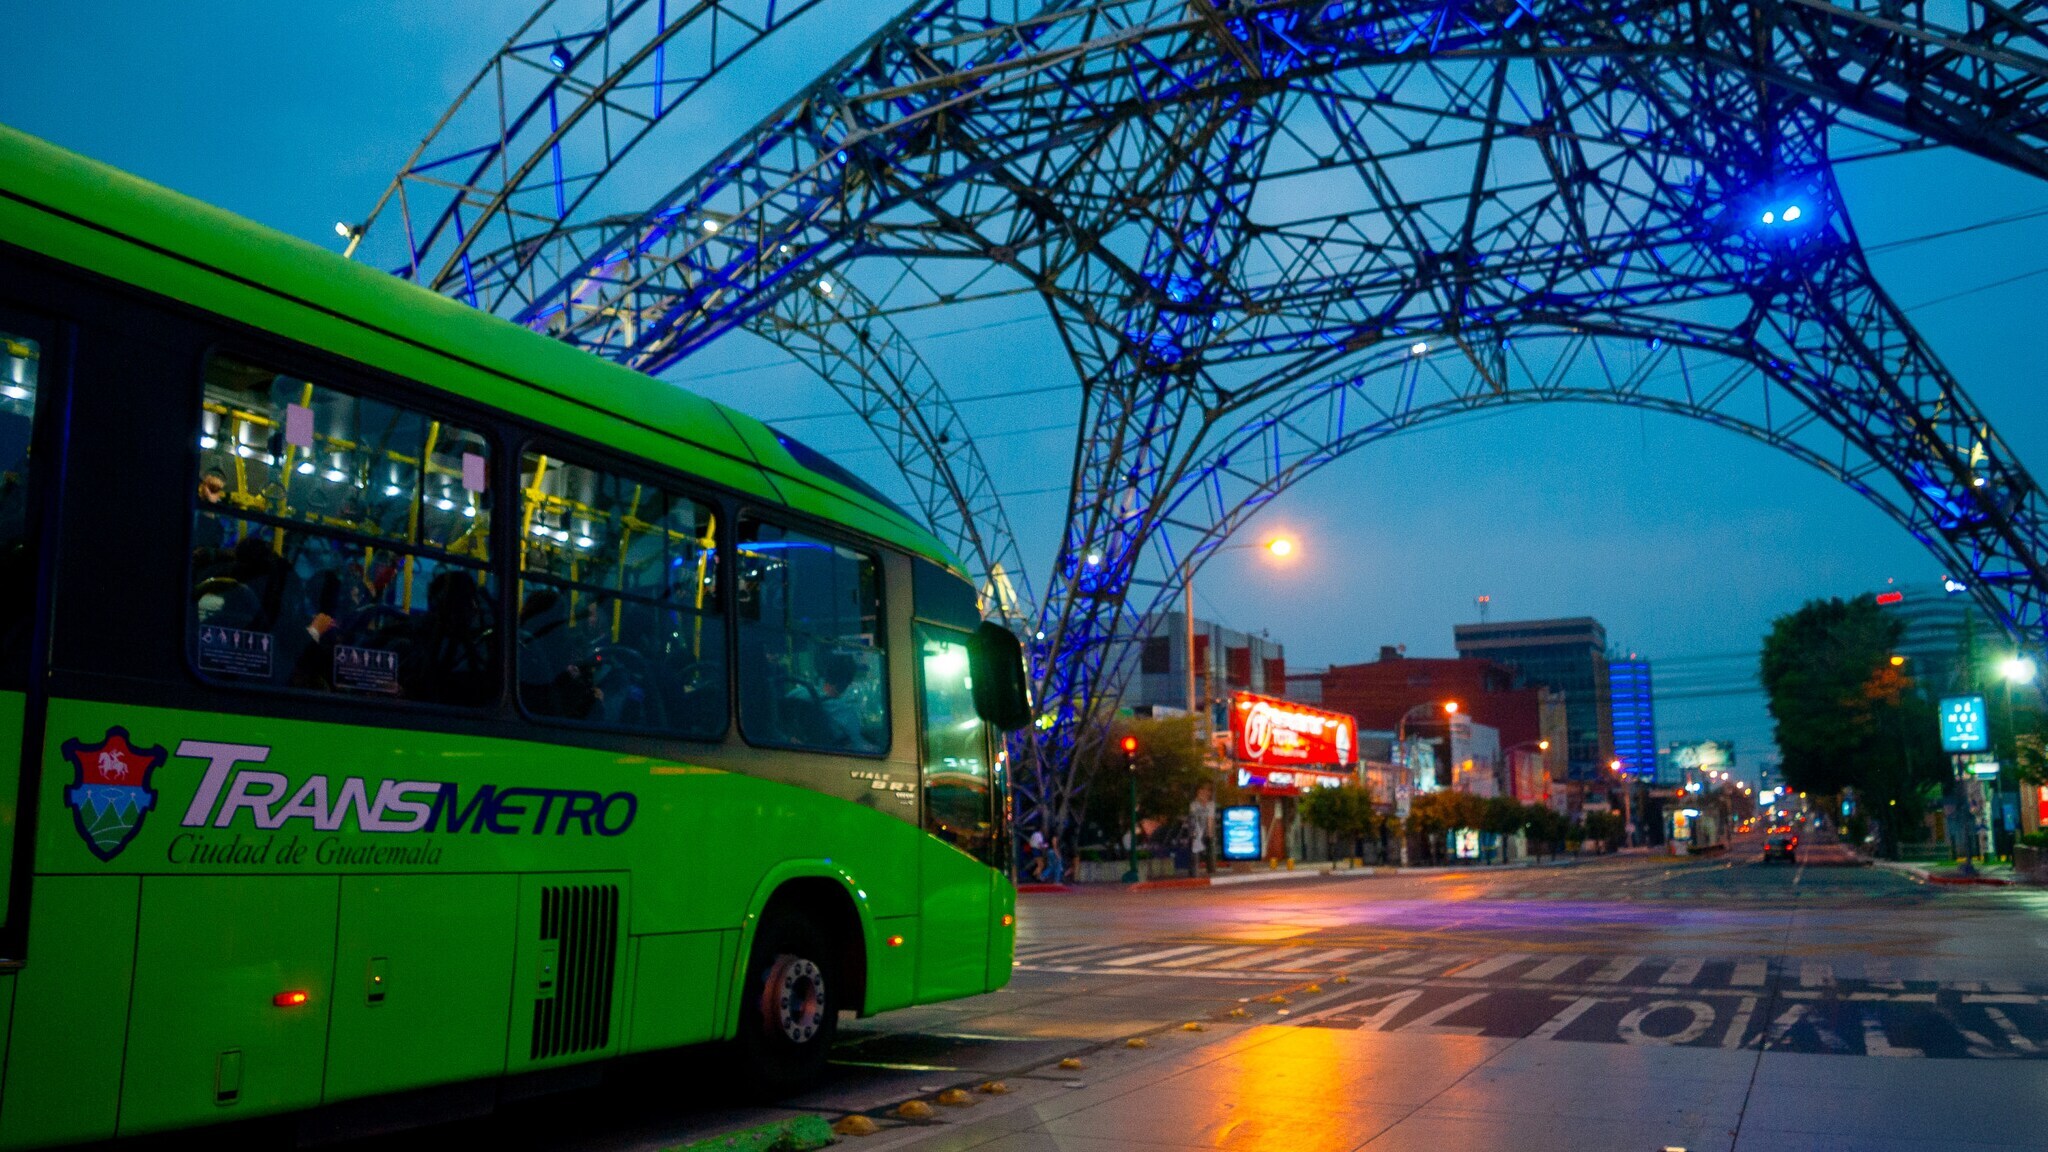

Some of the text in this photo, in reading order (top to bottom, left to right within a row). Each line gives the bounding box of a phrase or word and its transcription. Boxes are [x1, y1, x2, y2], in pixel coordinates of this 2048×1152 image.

[872, 780, 917, 791] BRT
[167, 833, 443, 866] Ciudad de Guatemala
